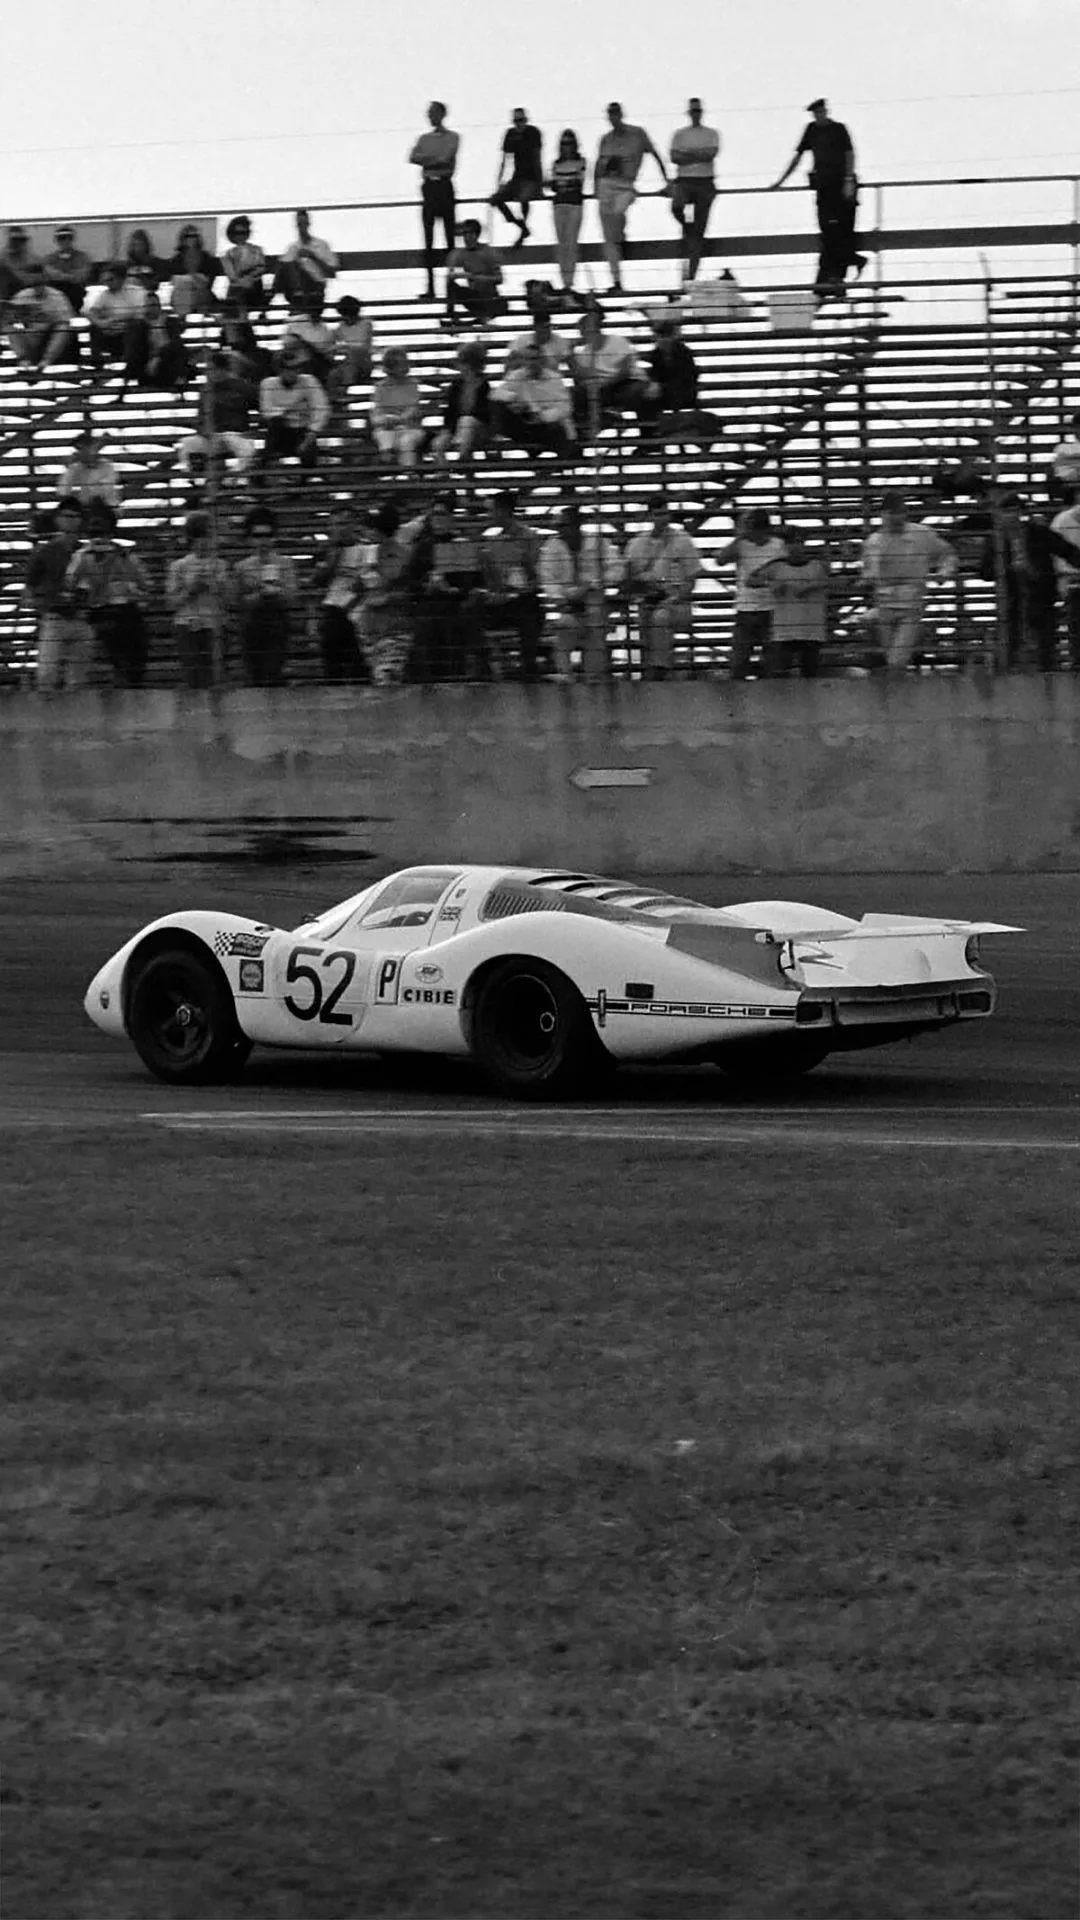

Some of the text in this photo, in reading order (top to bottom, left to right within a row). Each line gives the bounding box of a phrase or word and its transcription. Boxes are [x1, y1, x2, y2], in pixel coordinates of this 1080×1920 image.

[284, 946, 356, 1025] 52
[378, 960, 398, 998] P
[404, 989, 454, 1004] CIBIE
[631, 1002, 767, 1017] PORSCHE
